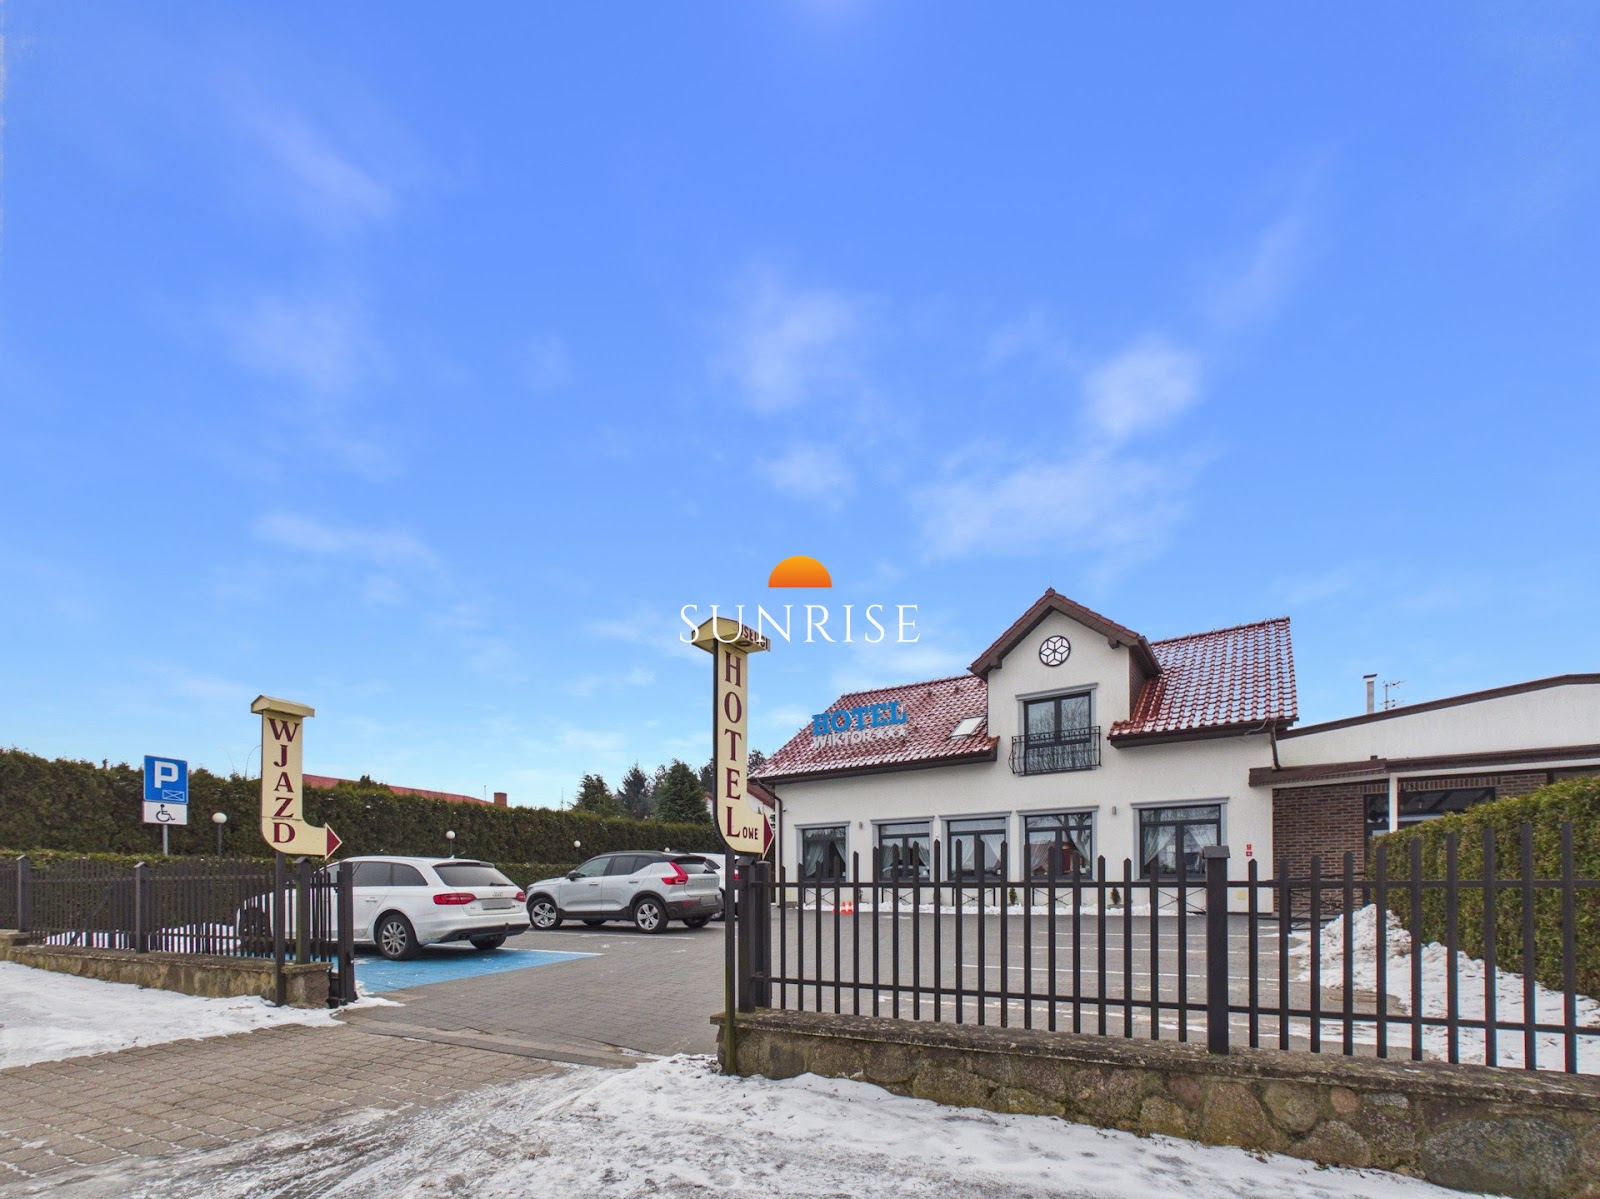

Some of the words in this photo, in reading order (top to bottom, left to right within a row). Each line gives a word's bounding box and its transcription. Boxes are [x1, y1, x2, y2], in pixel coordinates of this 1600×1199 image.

[812, 700, 907, 737] HOTEL
[154, 760, 179, 789] P
[267, 717, 300, 844] WJAZD
